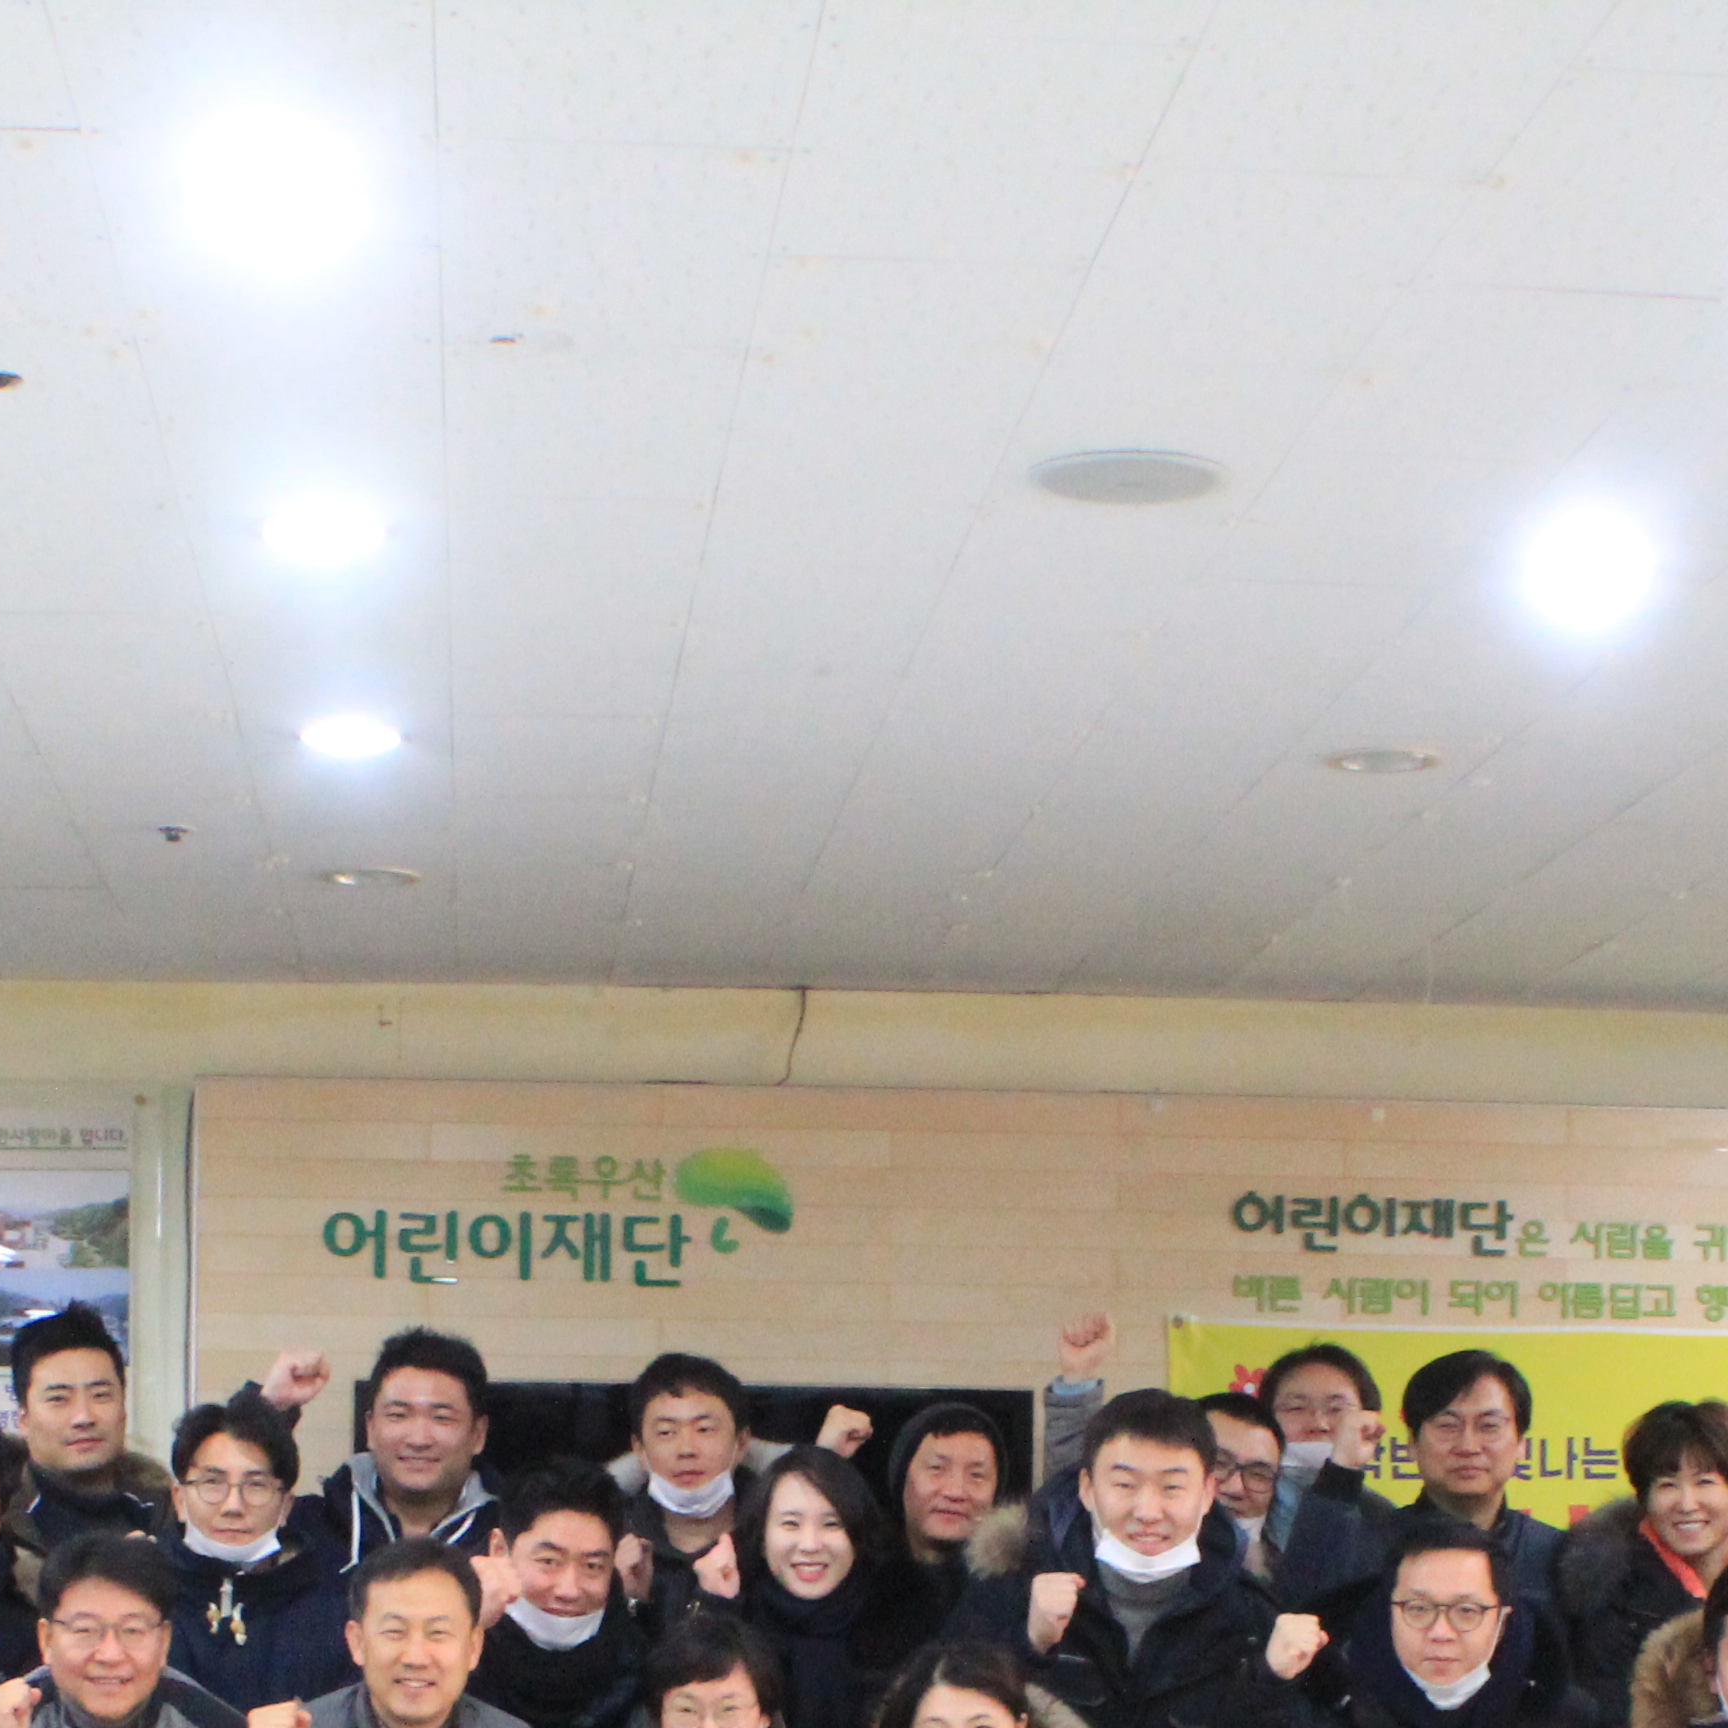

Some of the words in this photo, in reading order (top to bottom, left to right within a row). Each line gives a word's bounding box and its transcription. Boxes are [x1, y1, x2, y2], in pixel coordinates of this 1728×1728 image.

[502, 1151, 666, 1202] 초록우산
[322, 1206, 692, 1288] 어린이재단
[1570, 1221, 1674, 1261] 사람을
[1232, 1274, 1303, 1314] 바른
[1322, 1276, 1433, 1317] 사람이
[1447, 1279, 1520, 1319] 되어
[1537, 1281, 1678, 1321] 아름답고
